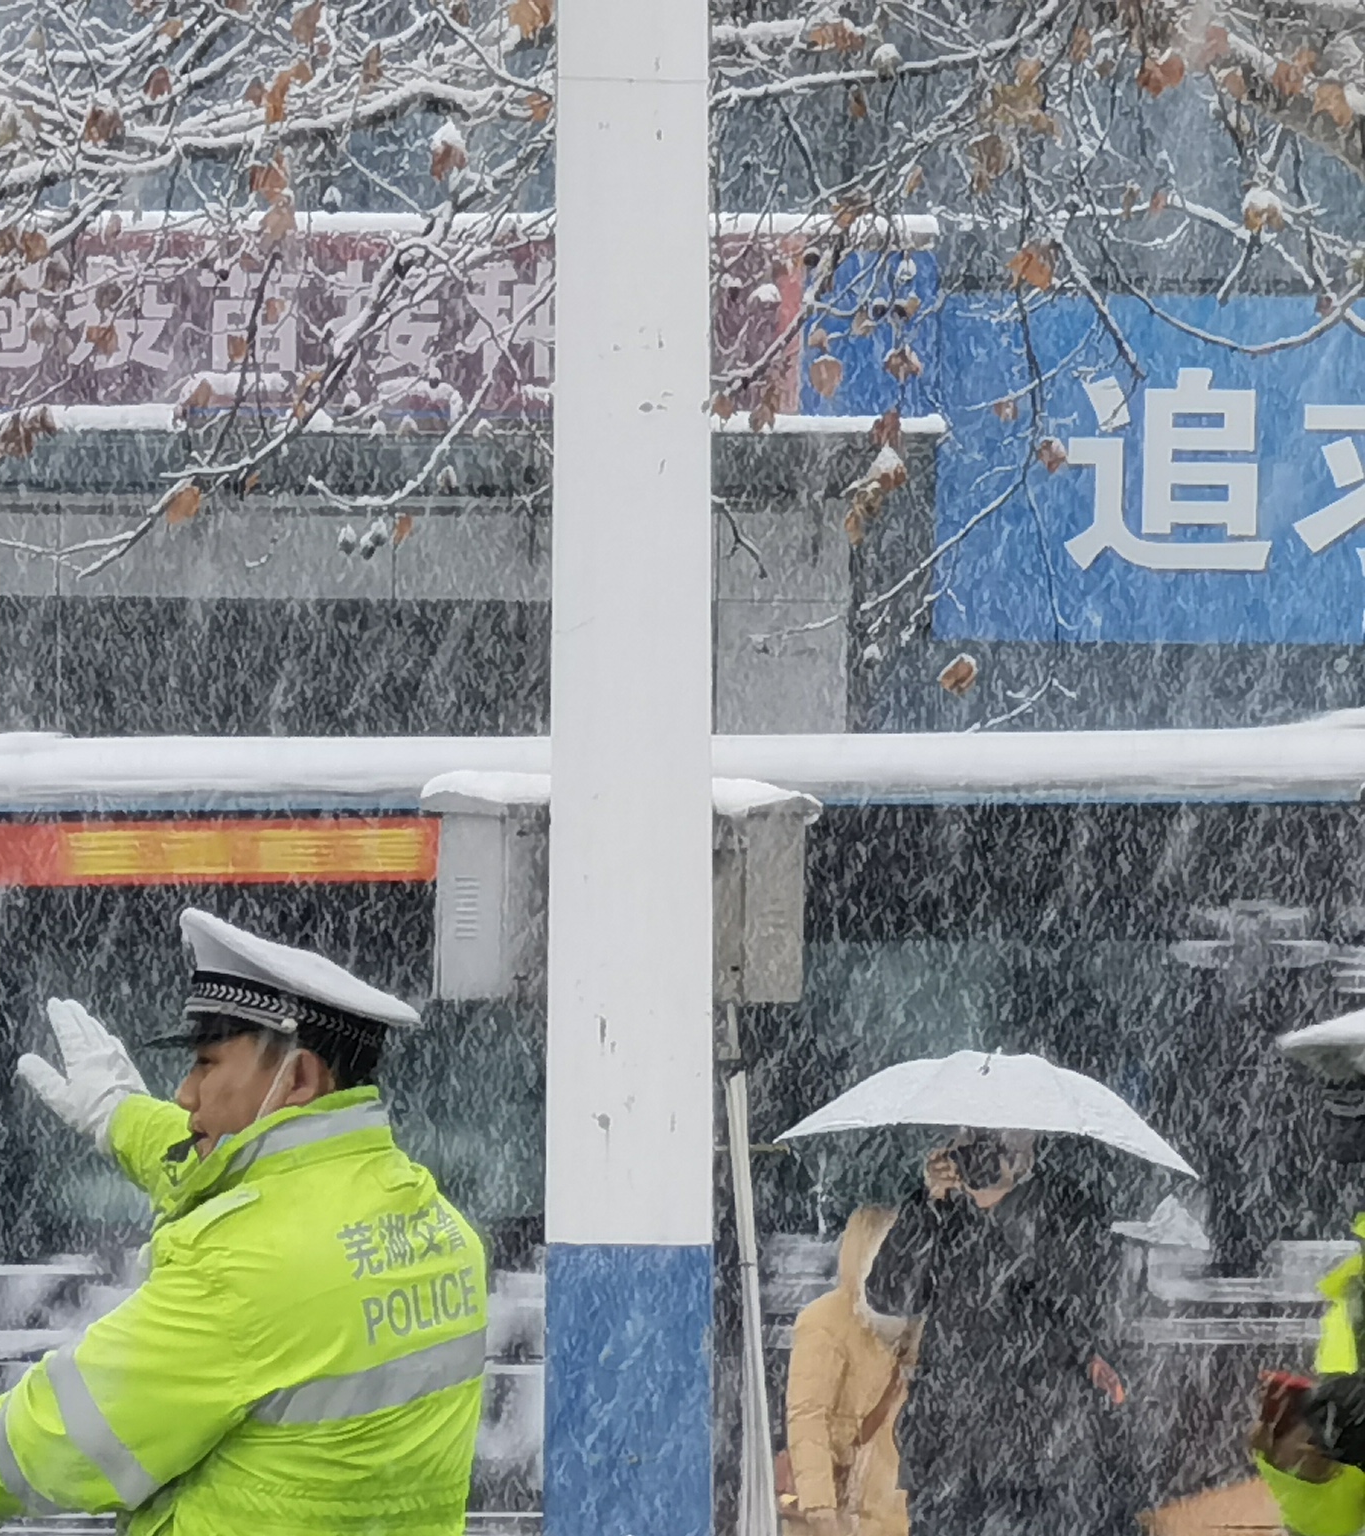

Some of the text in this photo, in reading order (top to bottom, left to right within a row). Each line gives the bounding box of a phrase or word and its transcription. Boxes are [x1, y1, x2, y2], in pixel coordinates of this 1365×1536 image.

[336, 1194, 467, 1280] 芜湖交警
[361, 1267, 478, 1346] POLICE
